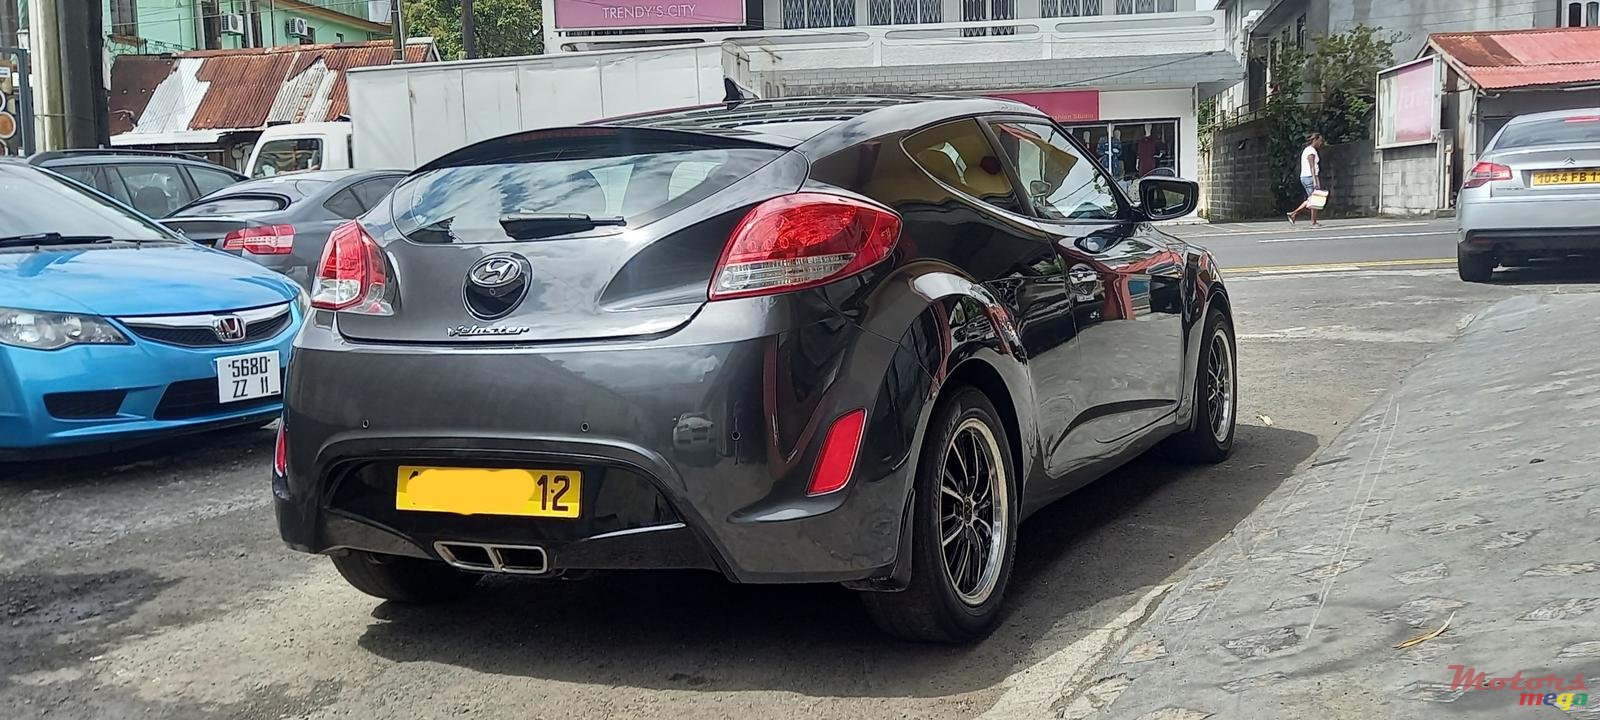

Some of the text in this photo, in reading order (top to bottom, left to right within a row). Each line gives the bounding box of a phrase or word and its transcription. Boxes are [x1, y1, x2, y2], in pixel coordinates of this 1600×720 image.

[602, 4, 696, 19] TRENDY'S CITY
[1571, 172, 1587, 182] FB
[232, 356, 268, 377] 5680
[232, 379, 248, 399] ZZ
[537, 475, 570, 511] 12
